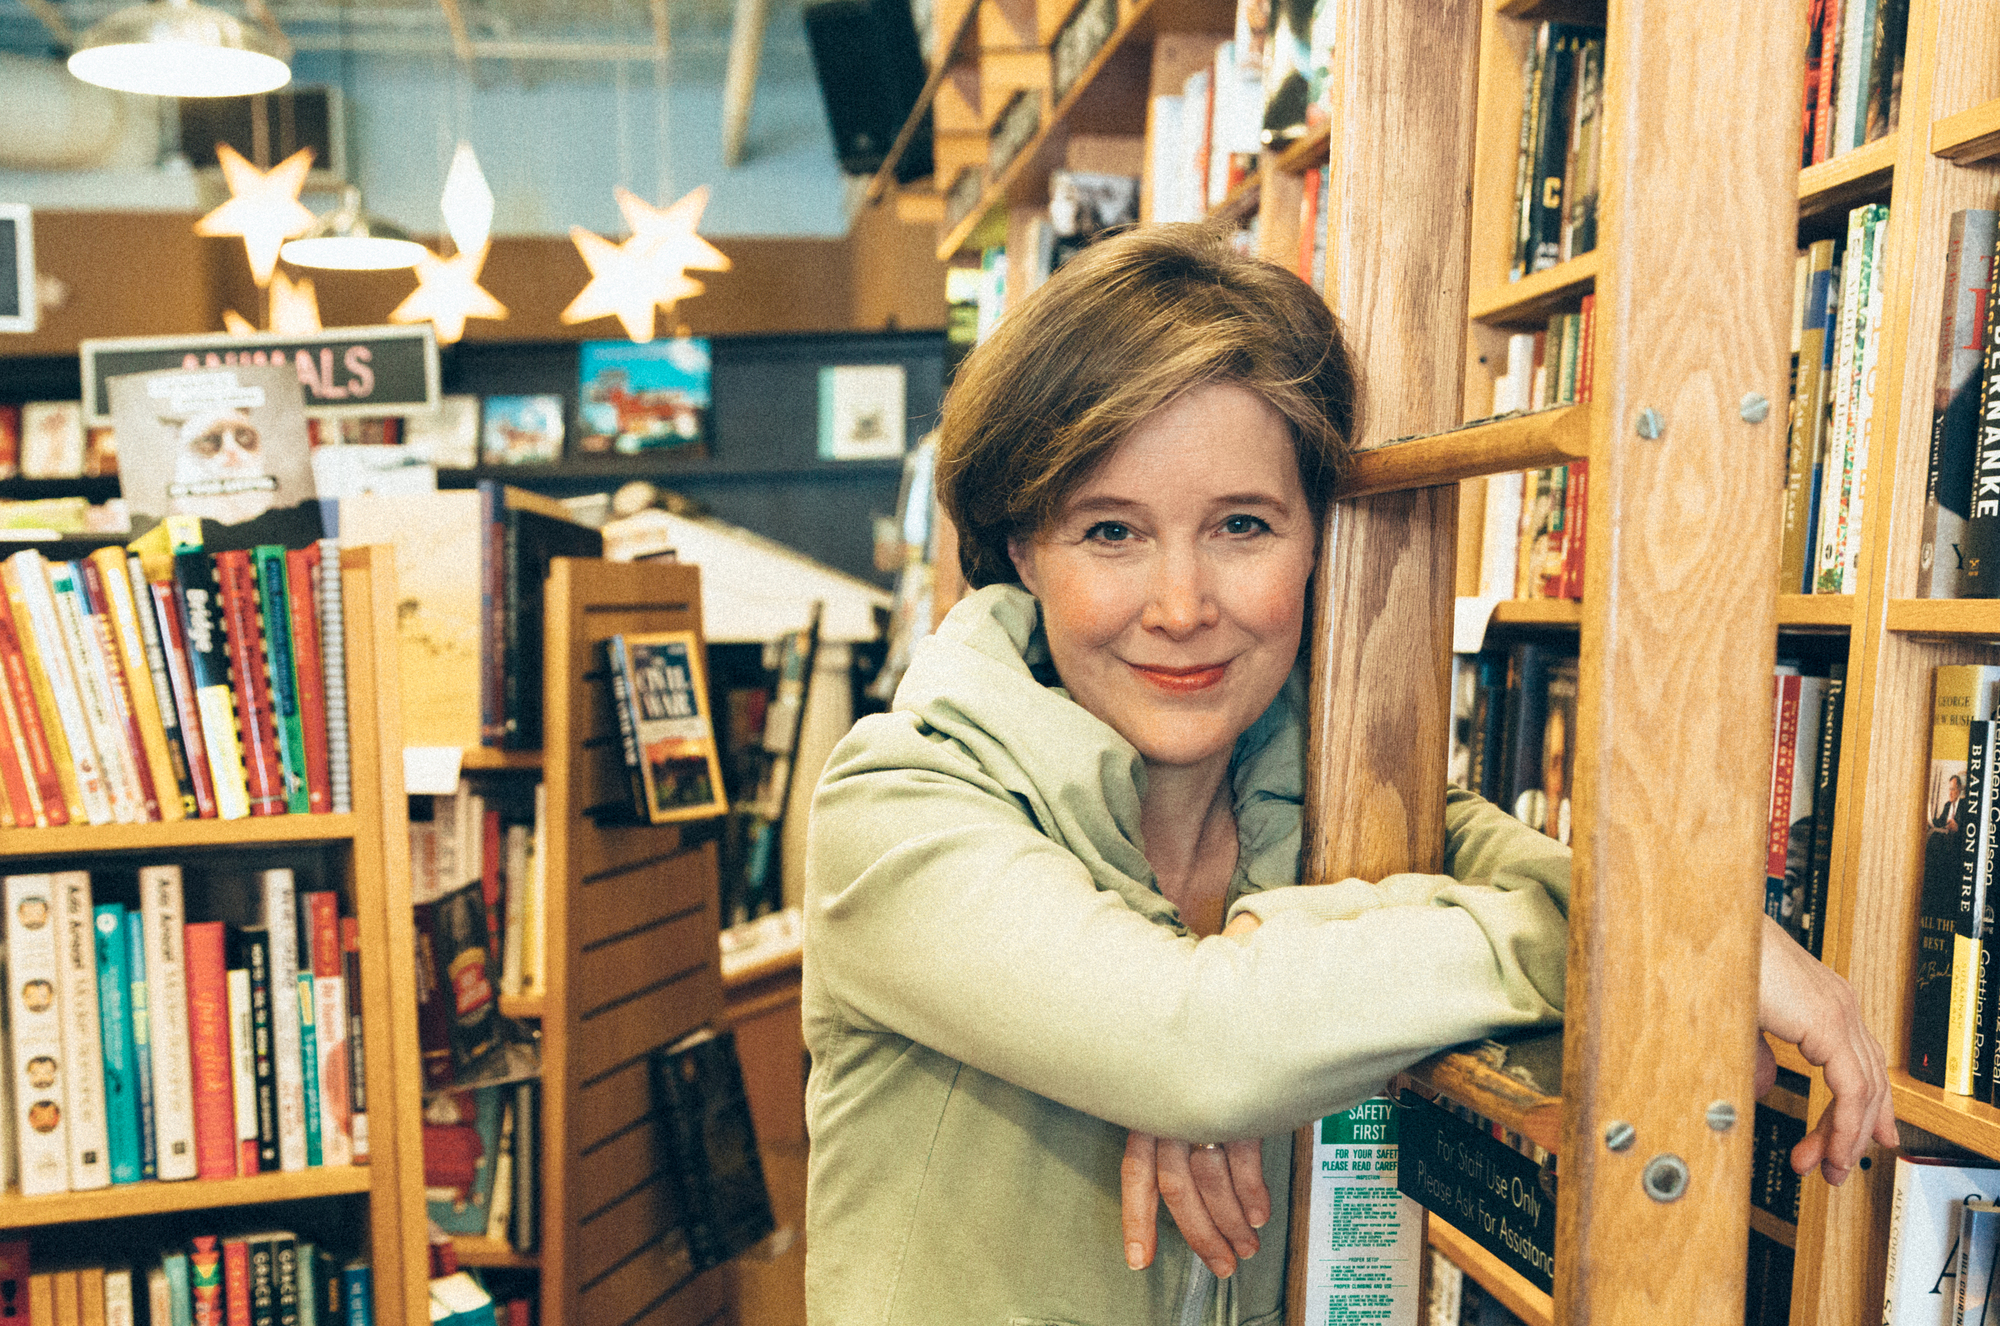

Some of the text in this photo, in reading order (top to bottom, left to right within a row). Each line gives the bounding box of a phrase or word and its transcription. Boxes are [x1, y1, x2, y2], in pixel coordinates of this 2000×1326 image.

[185, 588, 215, 654] Bridge
[1820, 678, 1843, 790] Rosemary
[1937, 695, 1971, 708] GEORGE
[1960, 743, 1984, 913] BRAIN ON FIRE
[1985, 806, 2000, 887] Carlson
[1920, 915, 1957, 933] ALL THE
[1972, 949, 1991, 1077] Getting Real
[1348, 1105, 1393, 1120] SAFETY
[1353, 1124, 1387, 1140] FIRST
[1322, 1161, 1349, 1171] PLEASE
[1352, 1161, 1372, 1171] READ
[1335, 1149, 1349, 1159] FOR
[1353, 1149, 1373, 1159] YOUR
[1437, 1129, 1541, 1228] For Staff Use Only
[1417, 1159, 1554, 1279] Please Ask For Assistanc
[1889, 1188, 1904, 1284] ALEX COOPER
[1956, 1252, 1969, 1326] BILL COURTN
